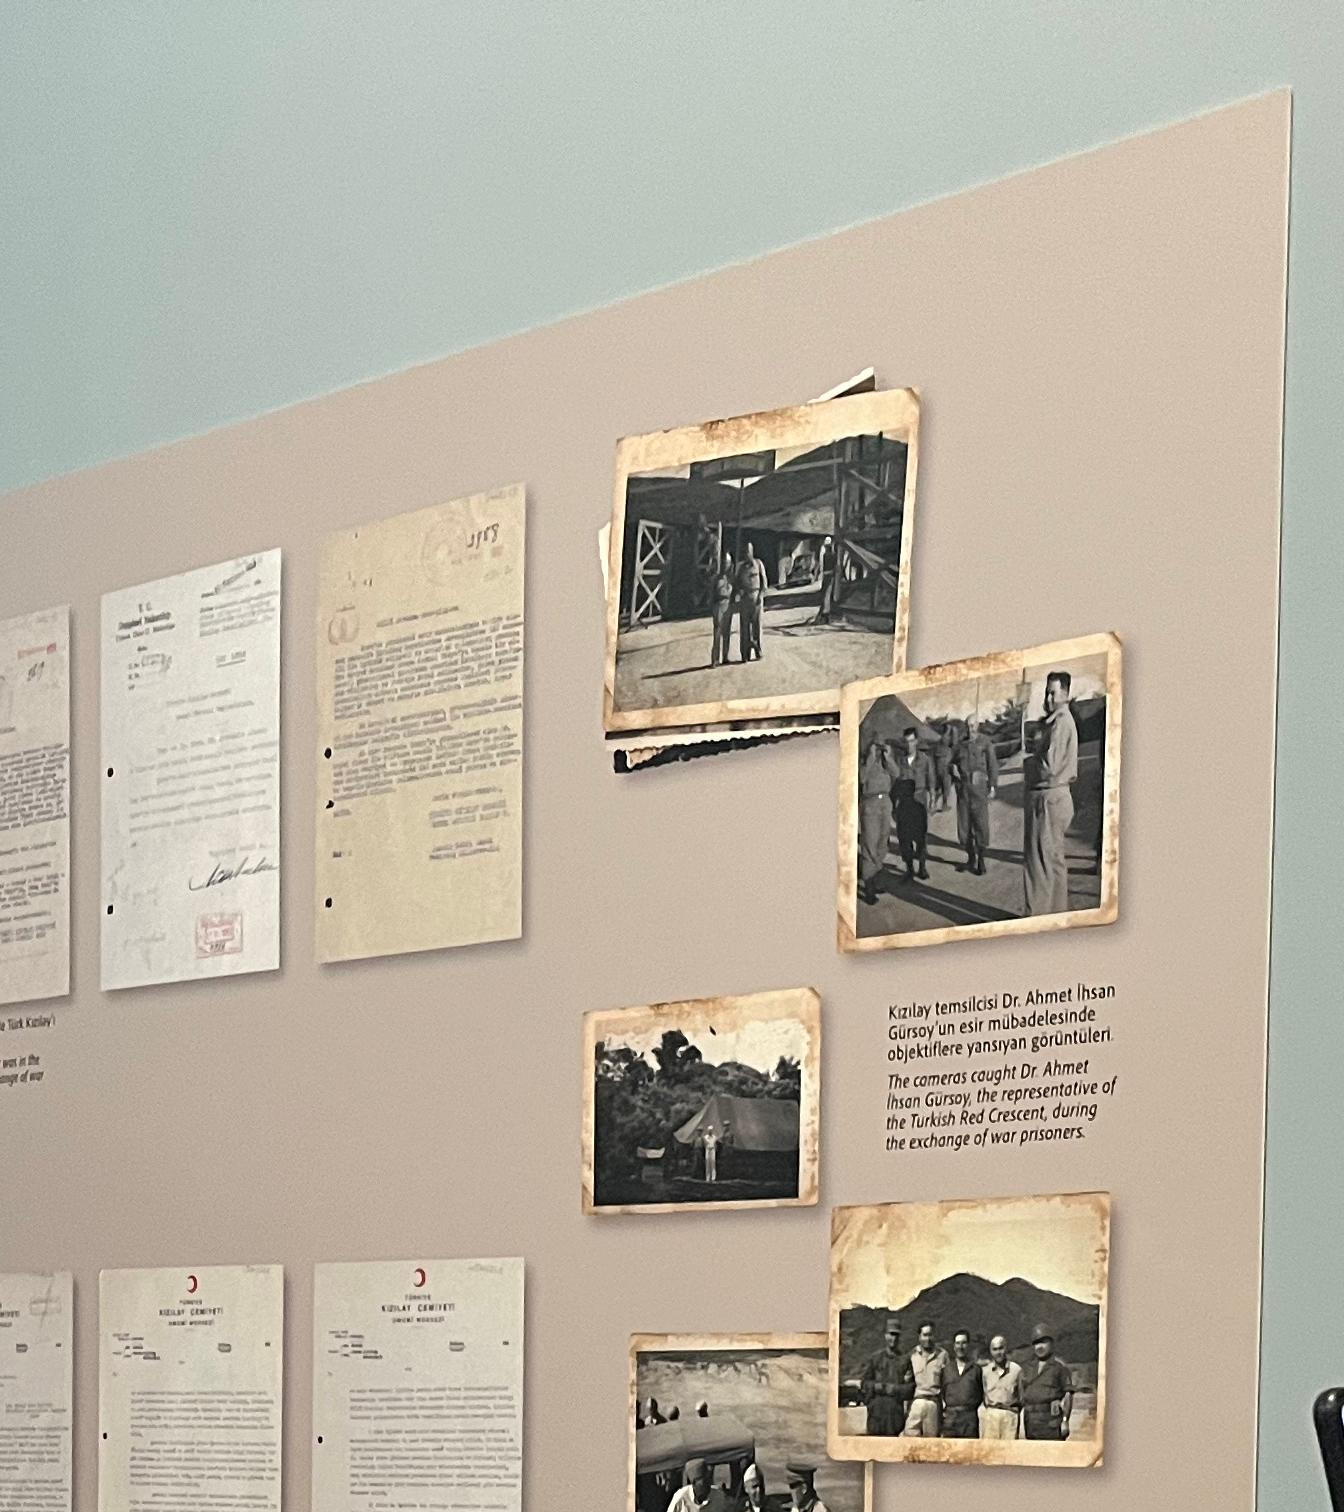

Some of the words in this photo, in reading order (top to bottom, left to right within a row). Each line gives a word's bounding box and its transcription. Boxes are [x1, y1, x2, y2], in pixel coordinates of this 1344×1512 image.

[889, 1003, 932, 1021] Kızılay
[935, 994, 998, 1016] temsilcisi
[1003, 993, 1021, 1008] Dr.
[1025, 988, 1072, 1006] Ahmet
[1077, 983, 1116, 1000] İhsan
[960, 1016, 984, 1034] esir
[988, 1006, 1096, 1031] mübadelesinde
[888, 1038, 963, 1064] objektiflere
[967, 1032, 1026, 1058] yansıyan
[888, 1074, 909, 1090] The
[914, 1070, 967, 1087] cameras
[971, 1065, 1016, 1085] caught
[1021, 1063, 1037, 1079] Dr.
[1043, 1060, 1089, 1077] Ahmet
[887, 1091, 920, 1110] İhsan
[925, 1089, 972, 1108] Gürsoy,
[977, 1086, 997, 1103] the
[1001, 1080, 1097, 1105] representative
[1102, 1076, 1117, 1097] of
[886, 1116, 905, 1130] the
[911, 1111, 955, 1128] Turkish
[960, 1109, 985, 1125] Red
[989, 1105, 1048, 1123] Crescent,
[1053, 1102, 1097, 1121] during
[885, 1136, 905, 1151] the
[909, 1130, 970, 1151] exchange
[974, 1128, 990, 1148] of
[991, 1130, 1016, 1144] war
[1020, 1125, 1085, 1146] prisoners.
